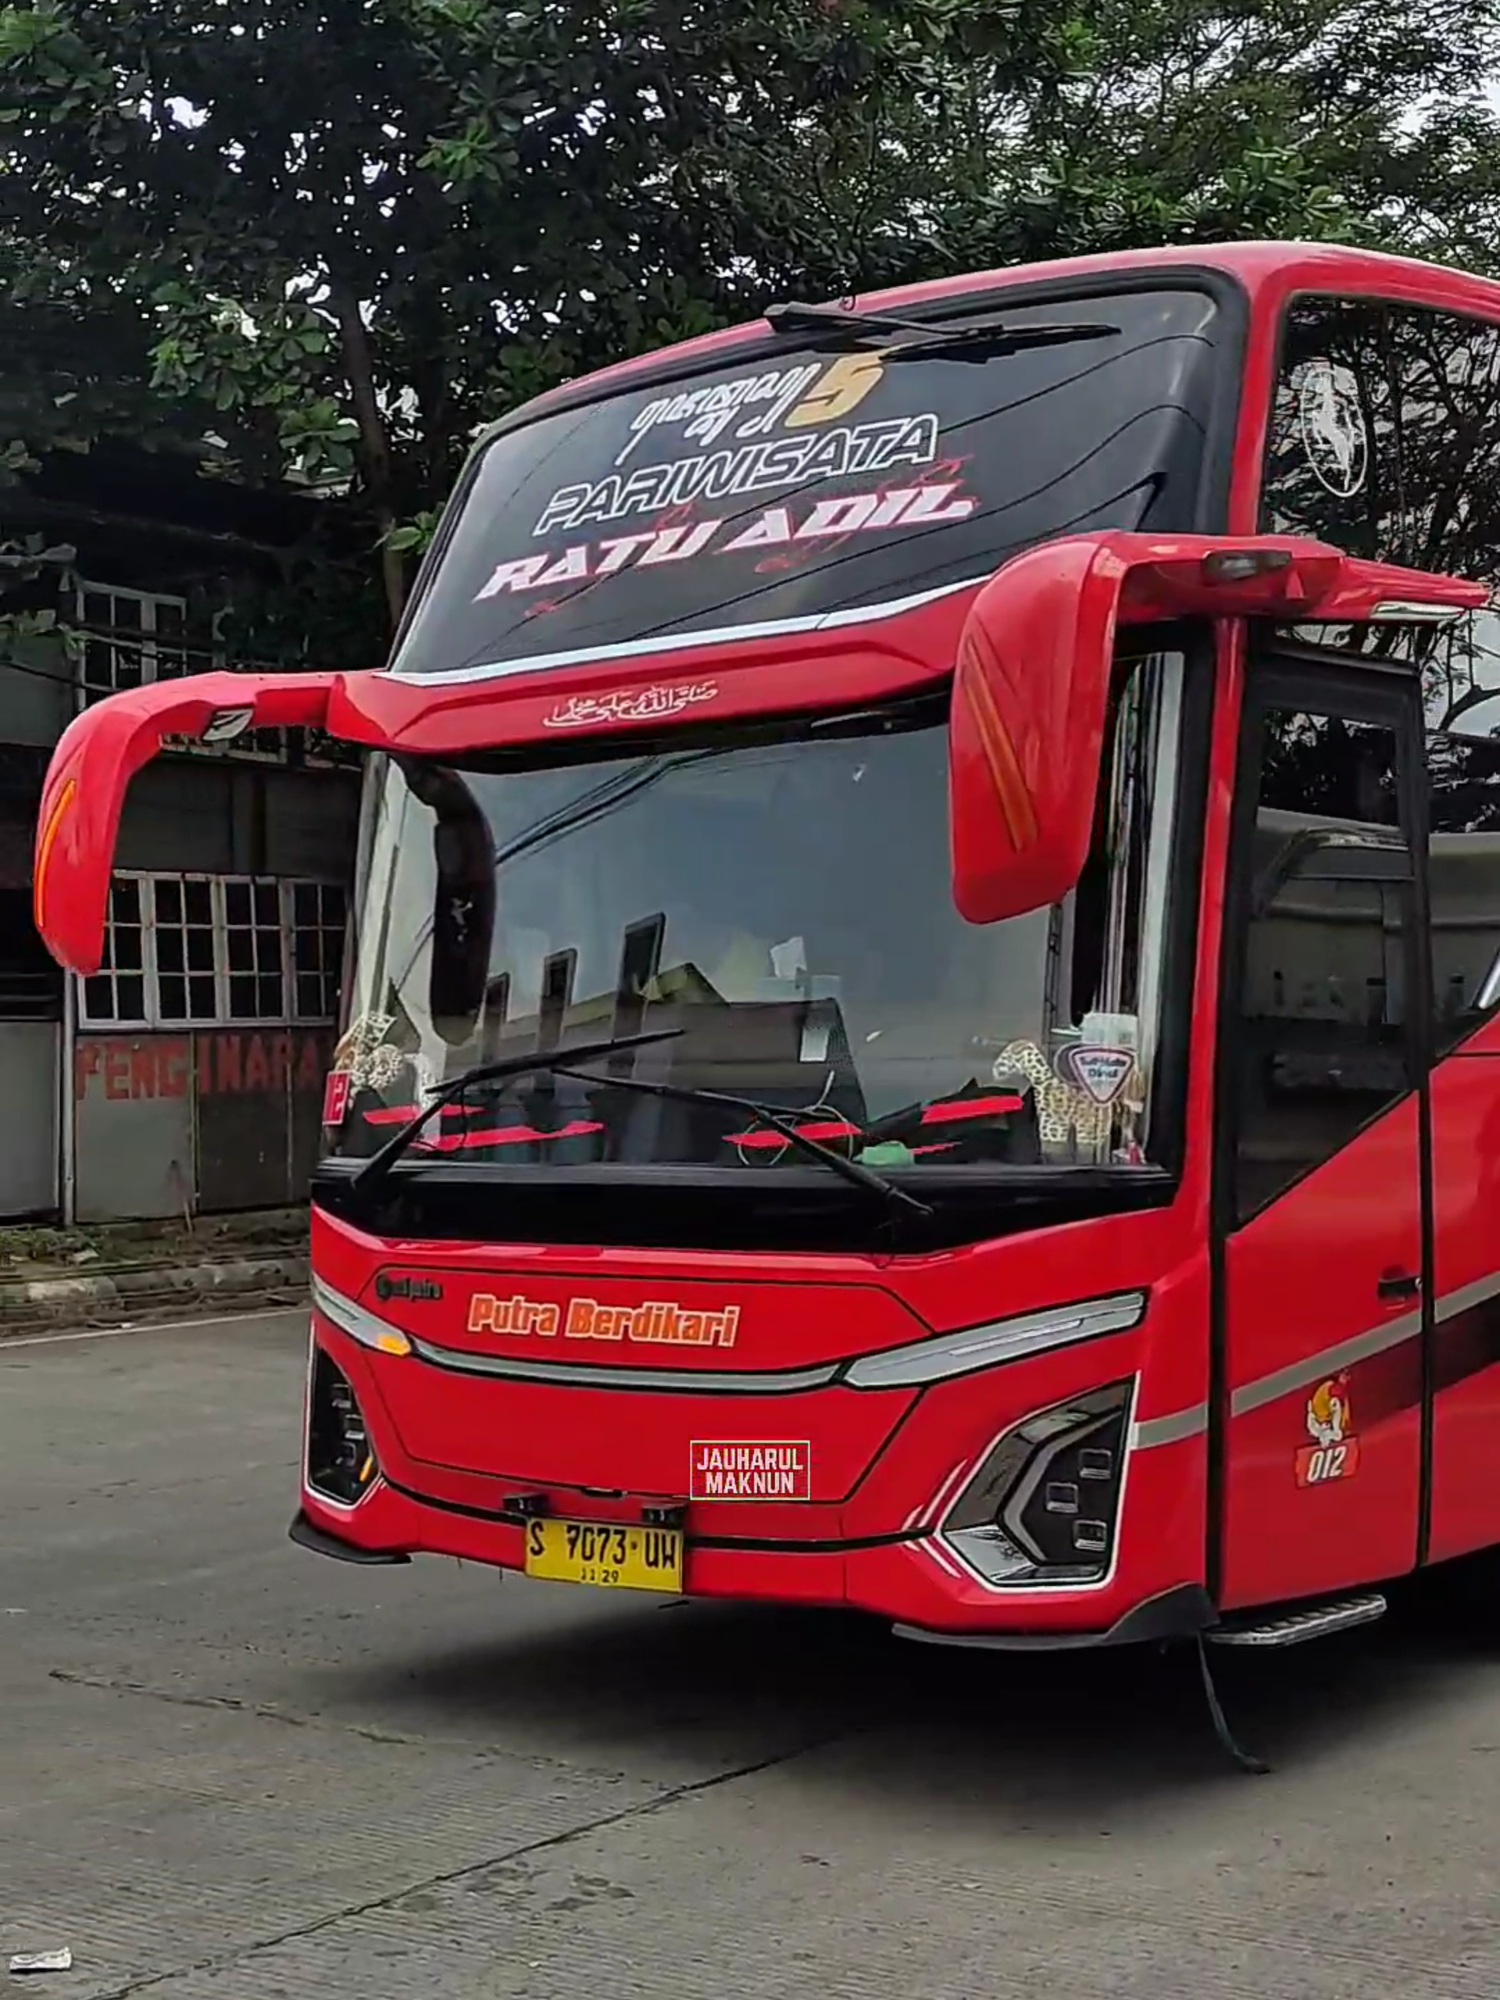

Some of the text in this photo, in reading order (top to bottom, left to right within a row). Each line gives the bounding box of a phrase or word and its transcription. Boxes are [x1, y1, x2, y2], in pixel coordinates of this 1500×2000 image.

[533, 412, 939, 537] PARIWISATA
[473, 482, 976, 603] RATU ADIL
[467, 1293, 741, 1348] Putra Berdikari
[1306, 1446, 1347, 1483] 012
[530, 1521, 546, 1556] S
[565, 1524, 627, 1566] 7073
